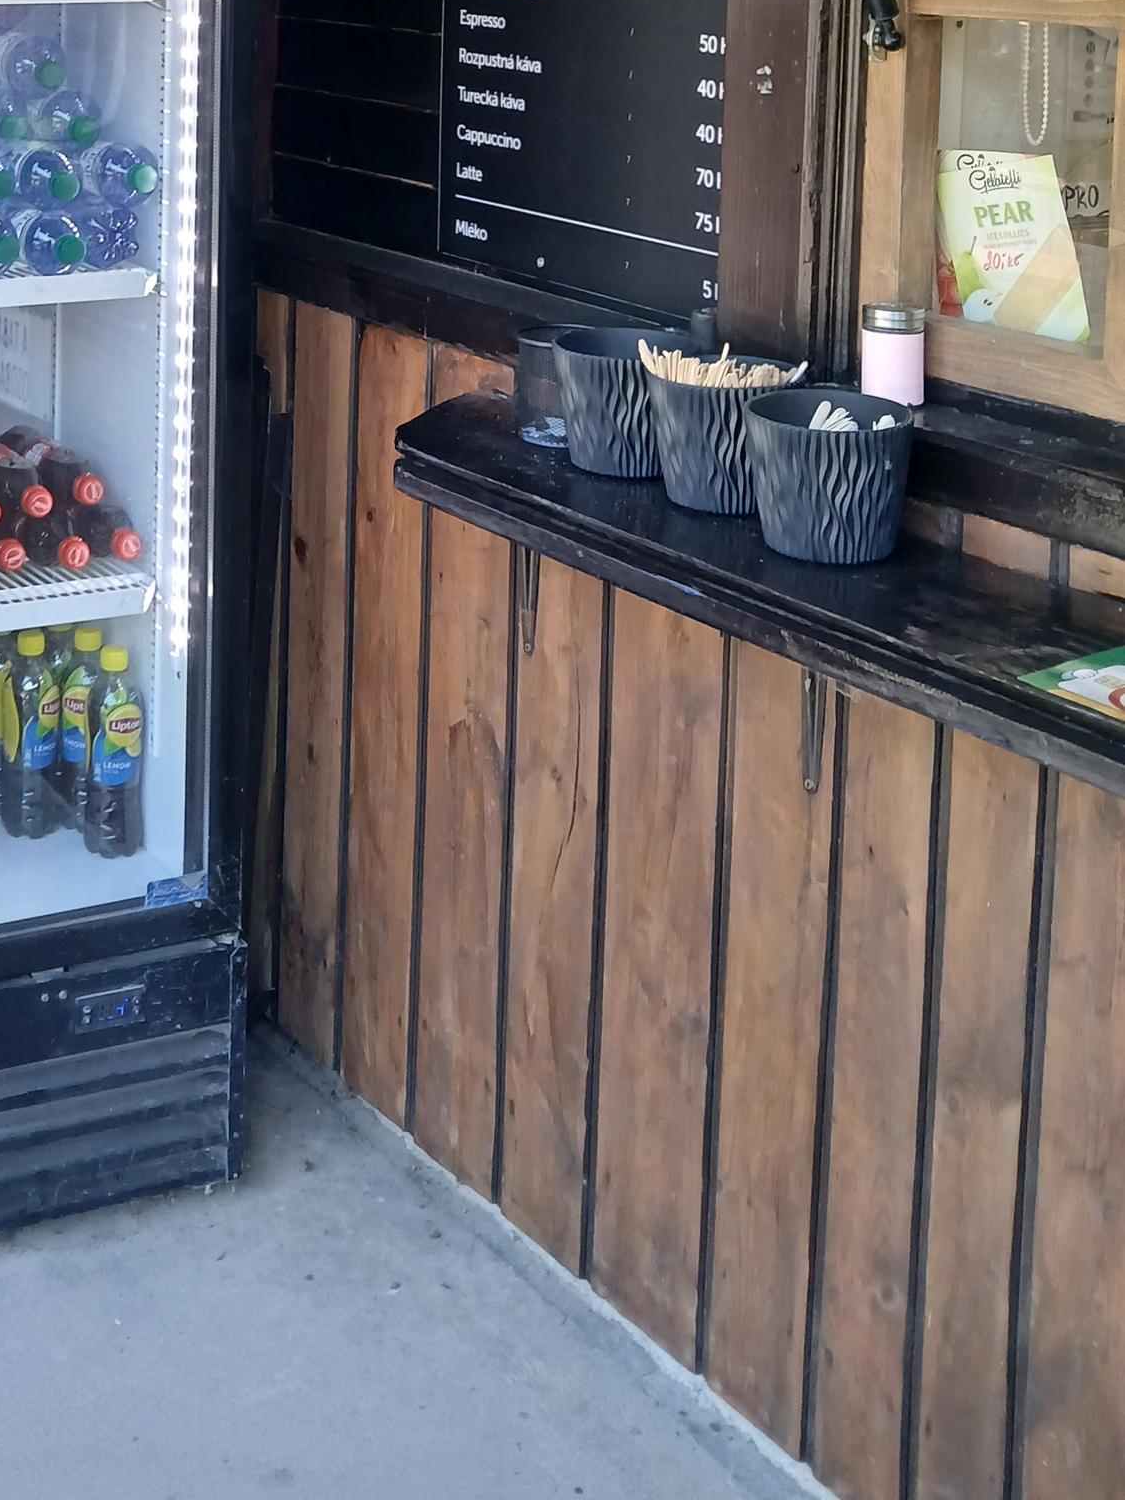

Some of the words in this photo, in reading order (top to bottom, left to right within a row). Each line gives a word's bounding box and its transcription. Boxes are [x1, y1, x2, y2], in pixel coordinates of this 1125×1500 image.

[459, 10, 506, 32] Espresso
[699, 34, 718, 55] 50
[459, 47, 515, 72] Rozpustná
[516, 55, 542, 75] káva
[697, 79, 717, 100] 40
[457, 86, 499, 107] Turecká
[500, 92, 526, 112] káva
[695, 124, 715, 145] 40
[456, 124, 522, 151] Cappuccino
[695, 168, 715, 190] 70
[456, 162, 483, 183] Latte
[694, 212, 714, 233] 75
[969, 169, 1022, 194] Gelatelli
[455, 219, 488, 243] Mléko
[973, 200, 1035, 228] PEAR
[66, 699, 84, 711] Lipt
[103, 761, 131, 770] LEMON
